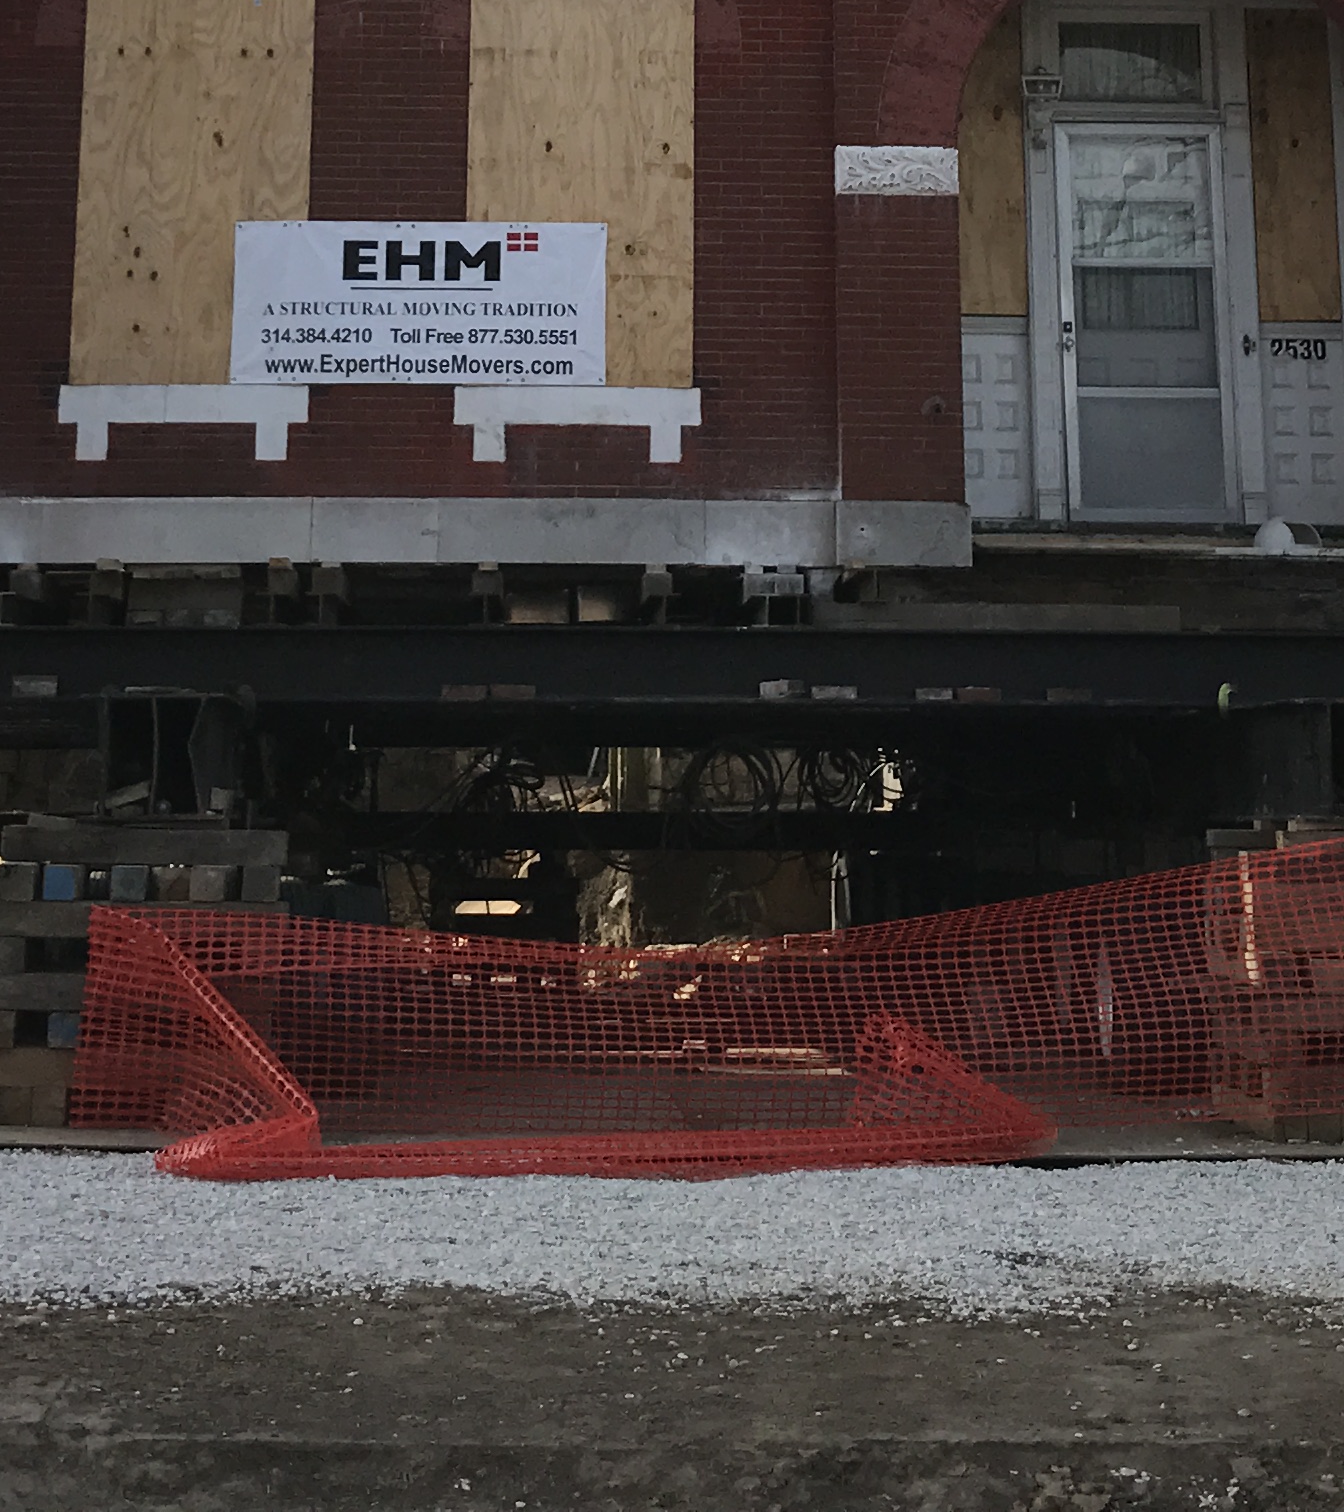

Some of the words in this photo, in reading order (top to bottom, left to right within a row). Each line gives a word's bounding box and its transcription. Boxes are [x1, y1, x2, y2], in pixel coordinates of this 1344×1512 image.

[342, 240, 502, 282] EHM
[262, 301, 275, 317] A
[279, 301, 398, 317] STRUCTURAL
[401, 301, 476, 318] MOVING
[480, 302, 579, 318] TRADITION
[260, 327, 373, 344] 314.384.4210
[389, 327, 421, 344] Toll
[425, 328, 464, 344] Free
[467, 328, 578, 346] 877.530.5551
[1269, 338, 1327, 361] 2530
[264, 354, 574, 377] www.ExpertHouseMovers.com
